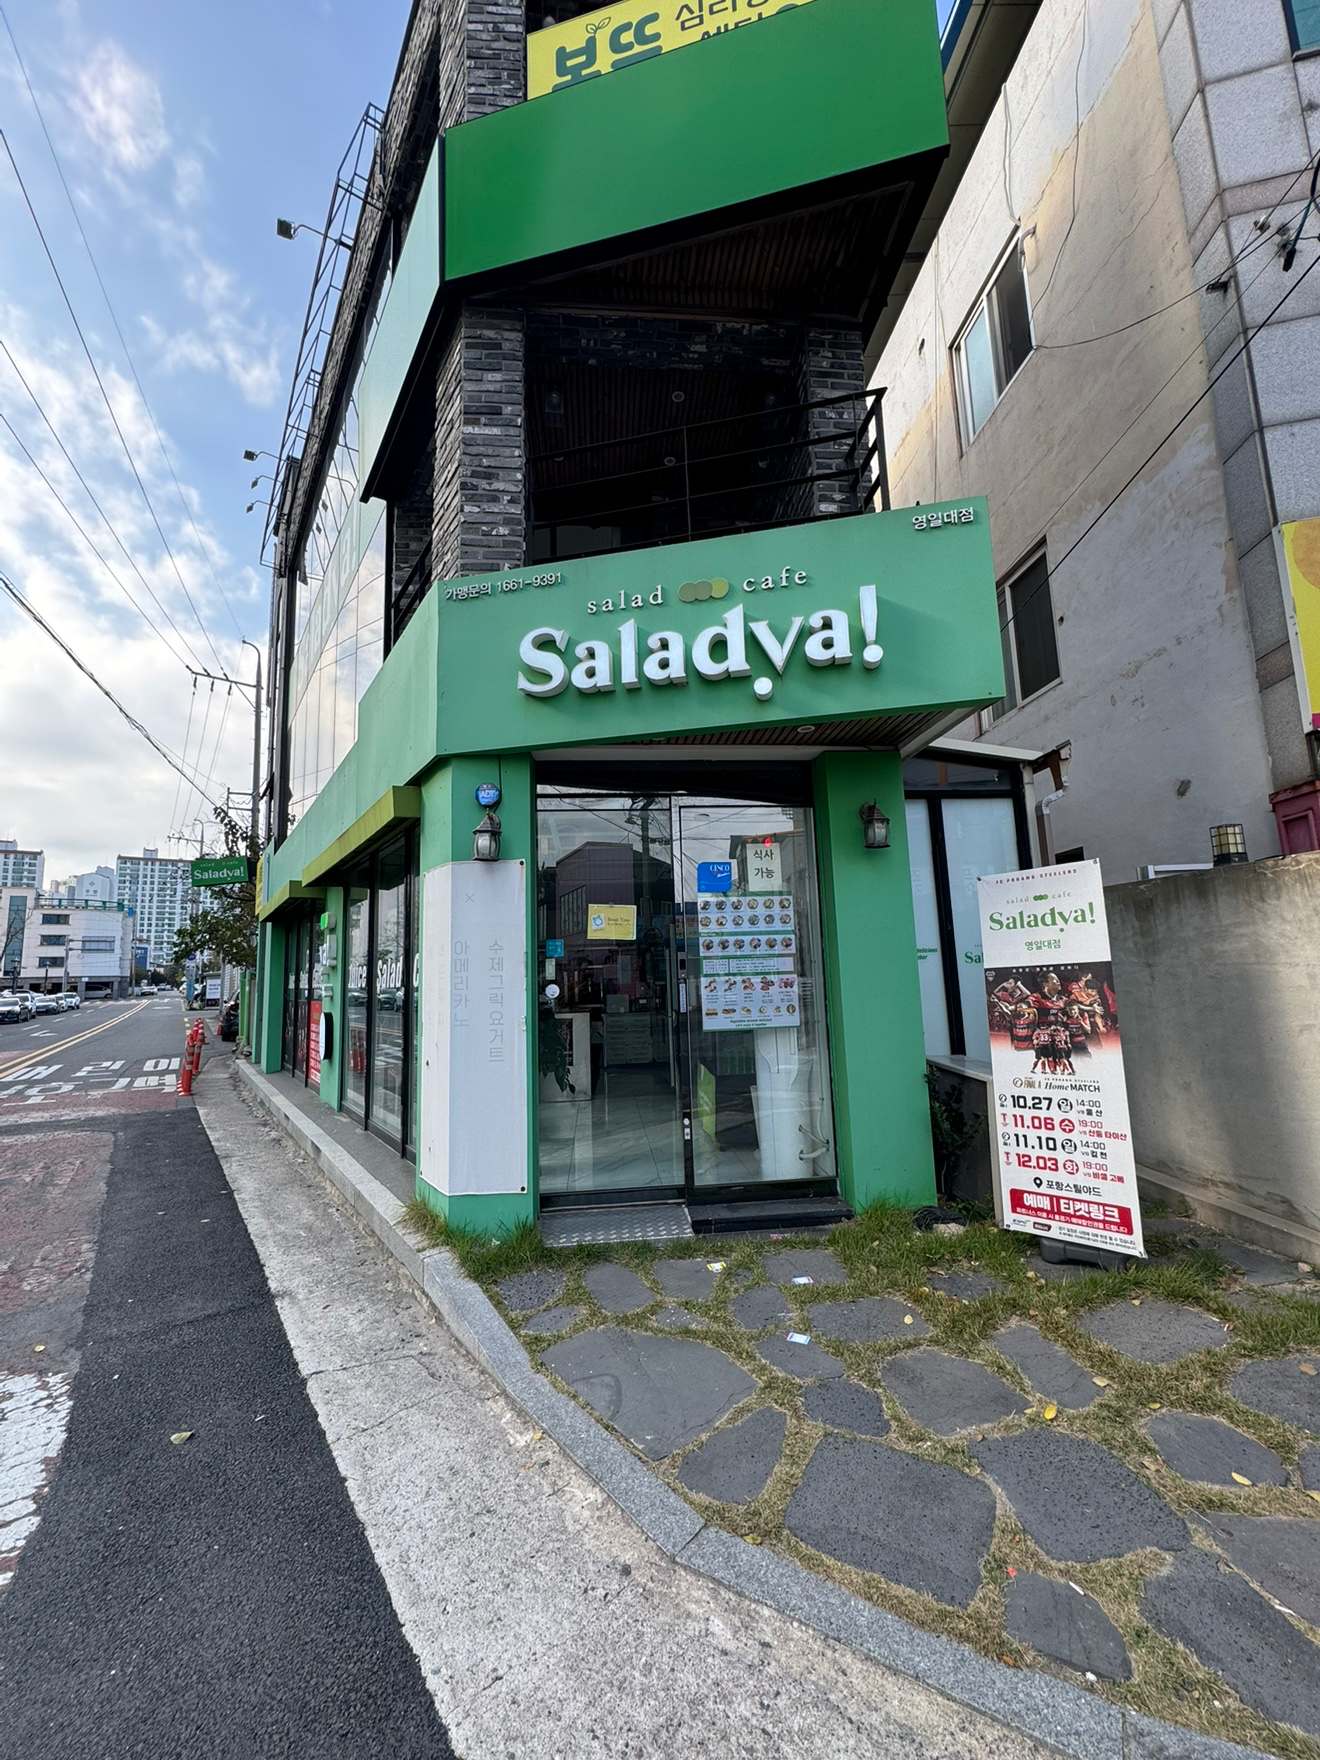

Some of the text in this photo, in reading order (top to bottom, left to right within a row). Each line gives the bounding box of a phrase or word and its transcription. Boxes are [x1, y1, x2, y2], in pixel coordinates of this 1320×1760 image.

[911, 507, 974, 532] 영일대점
[444, 571, 563, 600] 가맹문의 1661-9391
[586, 566, 808, 614] salad cafe
[517, 584, 884, 700] Saladva!
[753, 849, 774, 861] 식사
[193, 866, 244, 880] Saladva!
[754, 867, 775, 879] 가능
[1052, 891, 1071, 899] cafe
[989, 902, 1096, 933] Saladva!
[1025, 939, 1061, 951] 영일대점
[454, 940, 469, 1027] 아메리카노
[488, 940, 504, 1063] 수제그릭요거트
[1044, 1081, 1070, 1091] Home
[1070, 1083, 1101, 1093] MATCH
[1010, 1094, 1053, 1111] 10.27
[1076, 1099, 1101, 1108] 14:00
[1012, 1113, 1055, 1131] 11.06
[1060, 1119, 1074, 1133] 수
[1078, 1119, 1103, 1129] 19:00
[1014, 1133, 1057, 1151] 11.10
[1104, 1131, 1128, 1141] 타이산
[1080, 1140, 1106, 1150] 14:00
[1016, 1152, 1059, 1172] 12.03
[1064, 1160, 1078, 1174] 화
[1082, 1161, 1108, 1171] 19:00
[1046, 1180, 1102, 1196] 포항스틸야드
[1023, 1193, 1120, 1223] 예매 티켓링크
[1105, 1223, 1128, 1234] 드립니다
